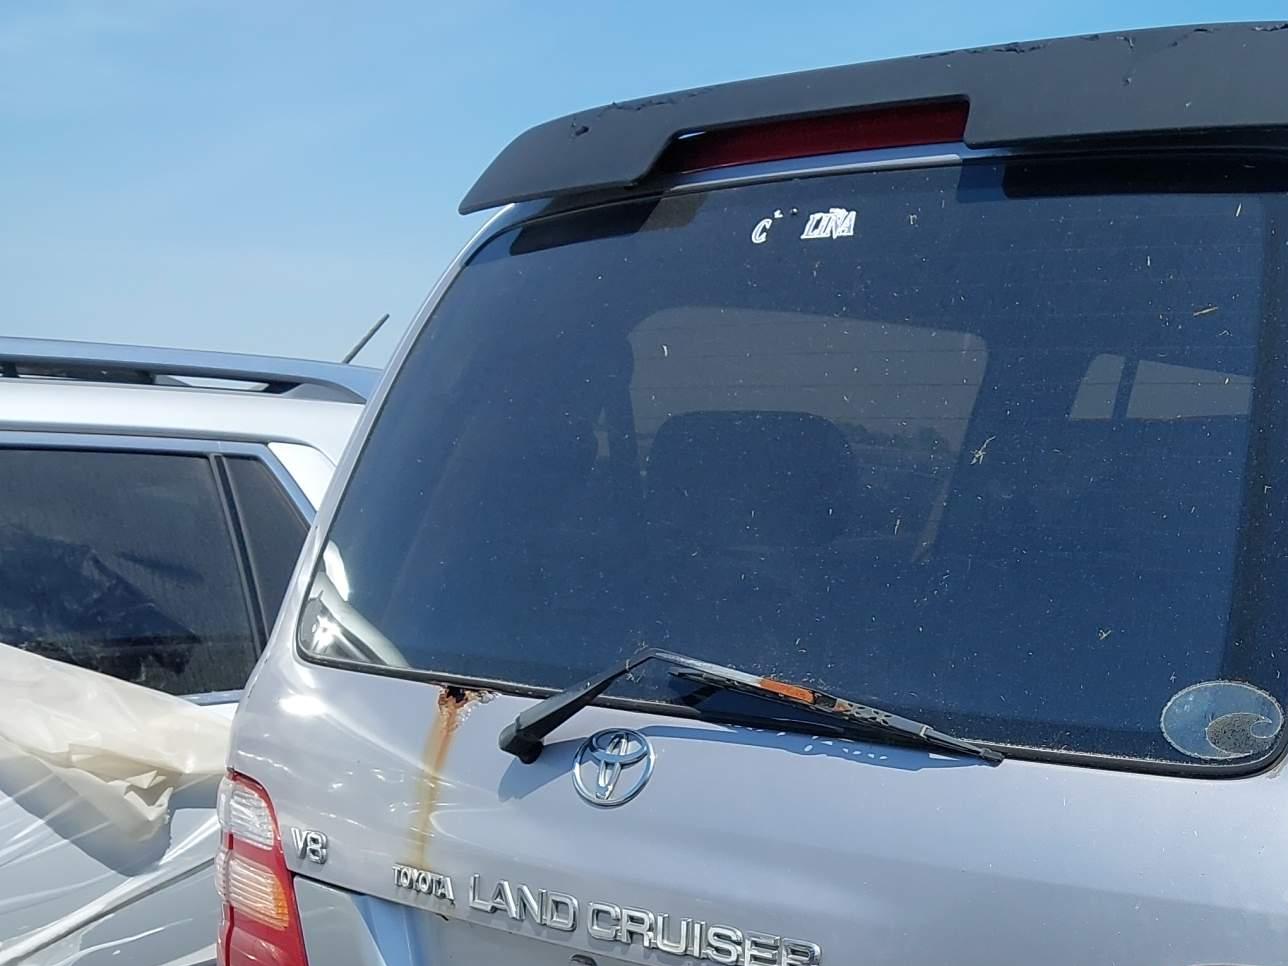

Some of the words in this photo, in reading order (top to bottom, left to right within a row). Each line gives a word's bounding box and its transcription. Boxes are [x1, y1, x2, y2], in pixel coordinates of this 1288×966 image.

[290, 827, 329, 865] V8
[391, 862, 456, 903] TOYOTA
[469, 873, 579, 932] LAND
